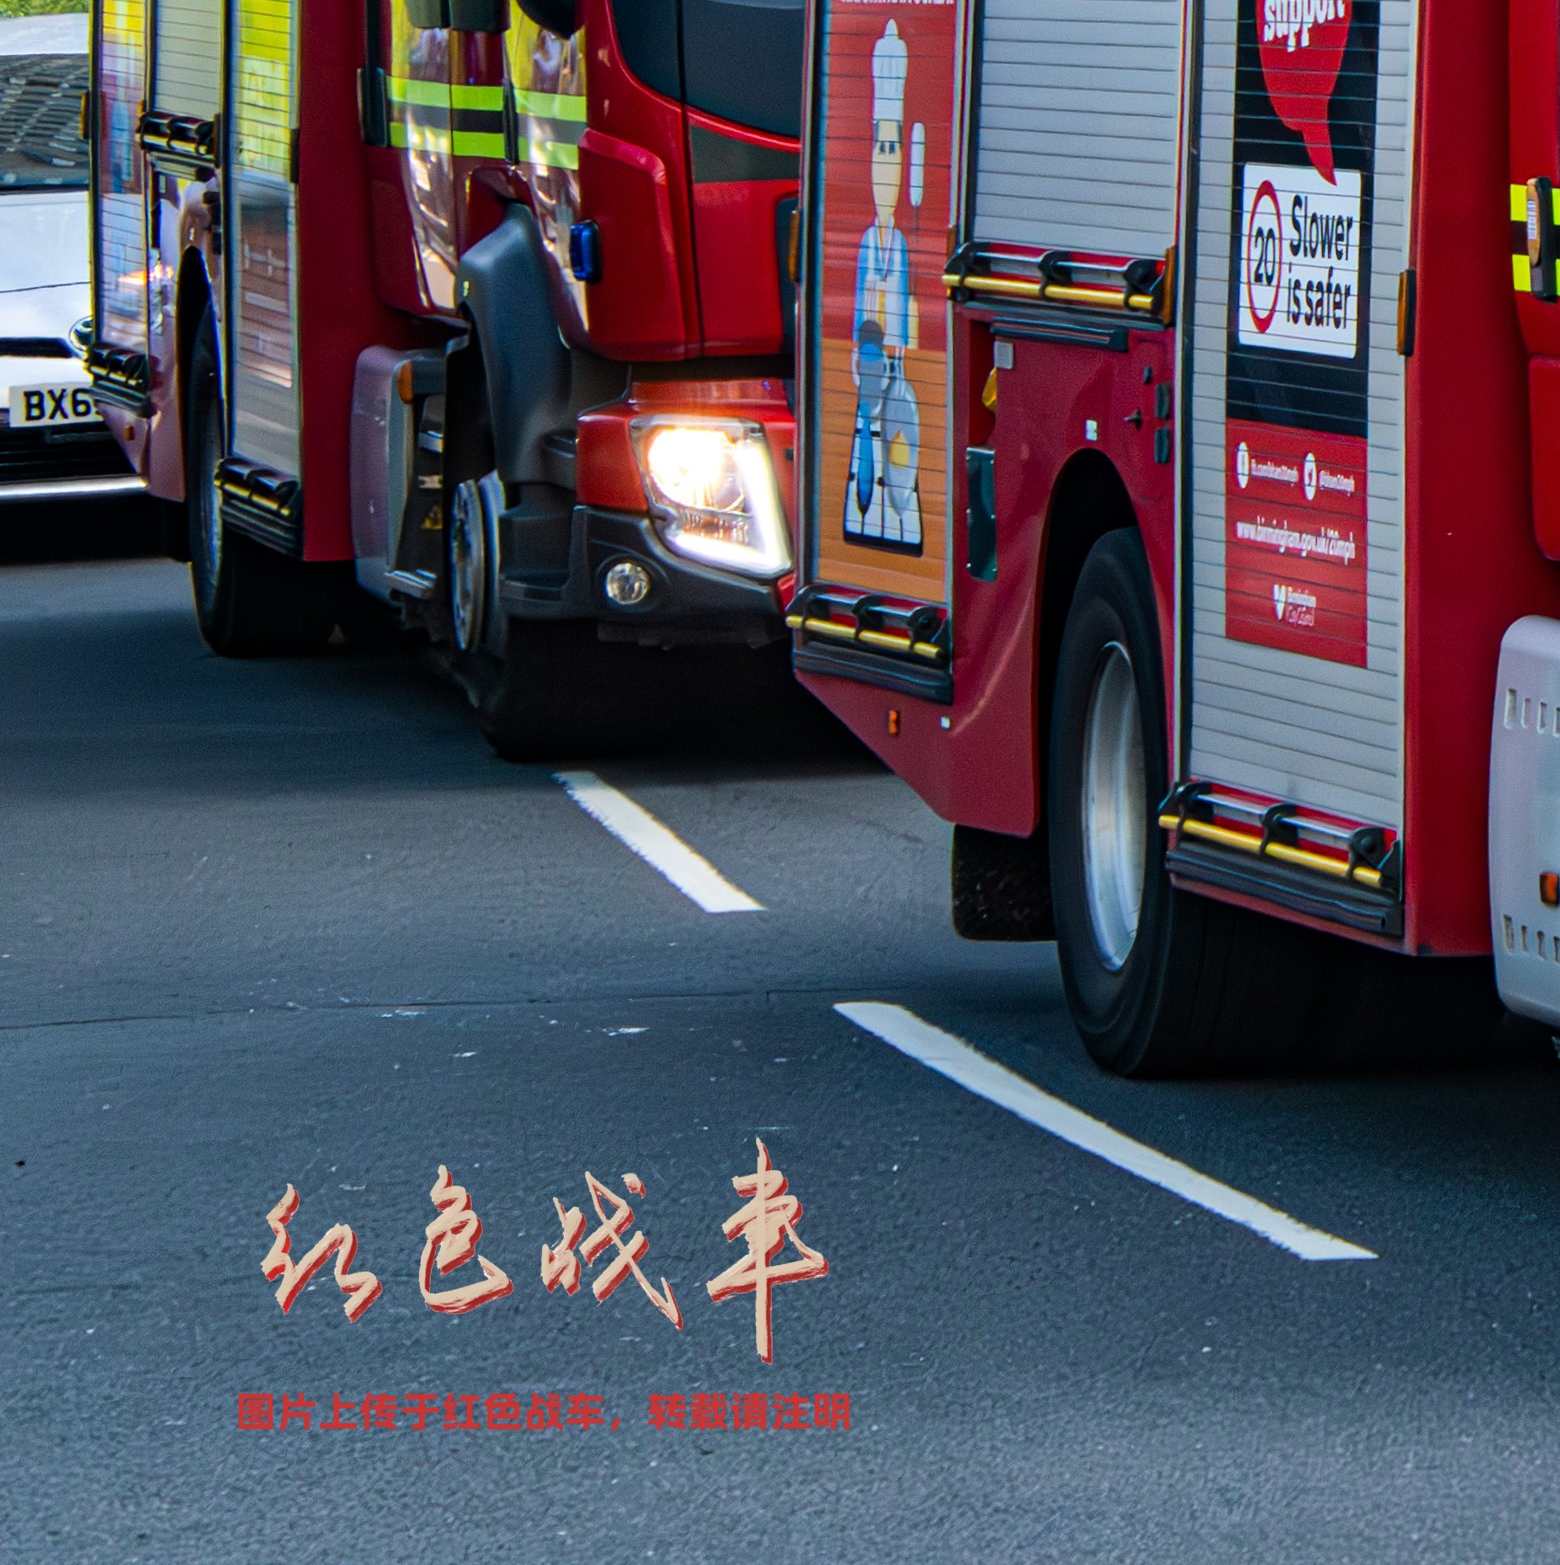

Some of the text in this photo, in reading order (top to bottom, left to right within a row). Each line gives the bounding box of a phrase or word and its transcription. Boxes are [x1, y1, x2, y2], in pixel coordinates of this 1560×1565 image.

[1254, 226, 1276, 286] 20
[1289, 194, 1354, 261] Slower
[1287, 262, 1351, 329] is safer
[23, 388, 94, 422] BX6
